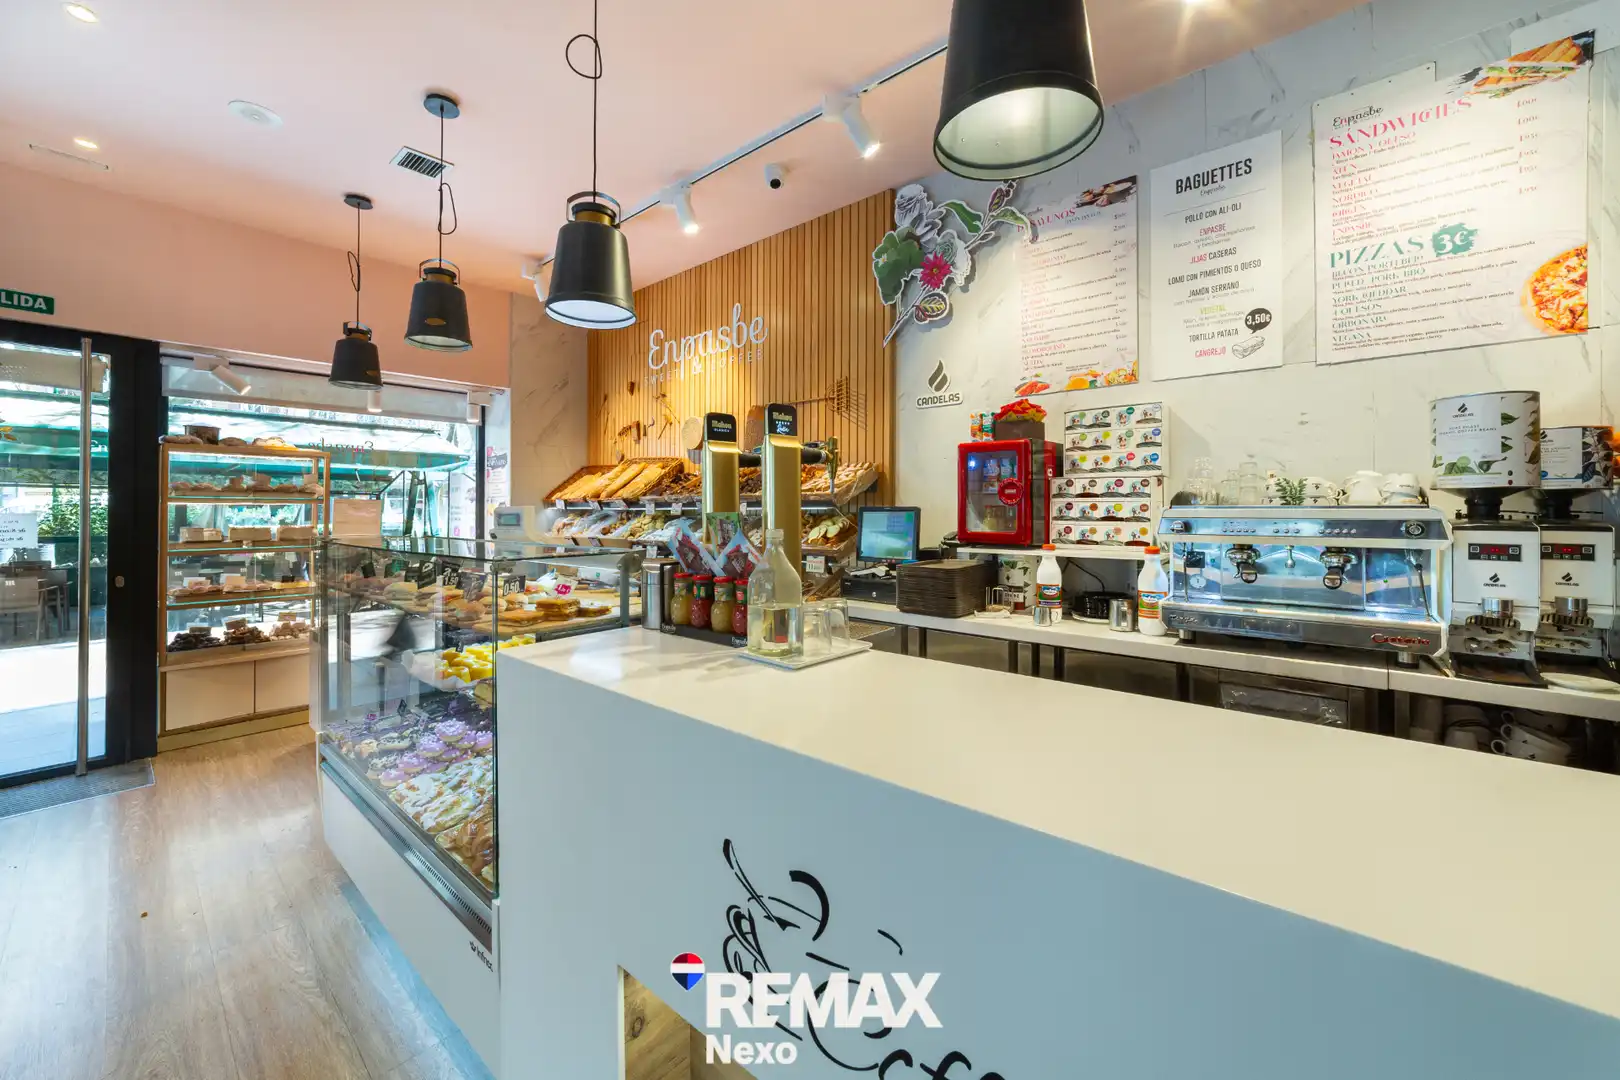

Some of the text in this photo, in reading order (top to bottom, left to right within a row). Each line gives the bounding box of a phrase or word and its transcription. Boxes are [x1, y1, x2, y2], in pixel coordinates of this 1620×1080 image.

[1175, 157, 1253, 195] BAGUETTES
[1184, 211, 1204, 224] POLLO
[1205, 209, 1218, 219] CON
[1199, 223, 1227, 236] ENPASBE
[1189, 247, 1237, 264] JIJAS CASERAS
[1329, 235, 1424, 269] PIZZAS
[1438, 230, 1469, 253] 3€
[1168, 274, 1185, 286] LOMO
[1186, 272, 1198, 282] CON
[1199, 265, 1232, 279] PIMIENTOS
[1240, 258, 1262, 271] QUESO
[1210, 280, 1239, 294] SERRANO
[0, 291, 47, 310] LIDA
[1246, 312, 1271, 326] 3,50€
[648, 302, 769, 381] Enpasbe
[1189, 328, 1239, 343] TORTILLA PATATA
[1194, 346, 1227, 358] CANGREJO
[916, 392, 960, 407] CANDELAS
